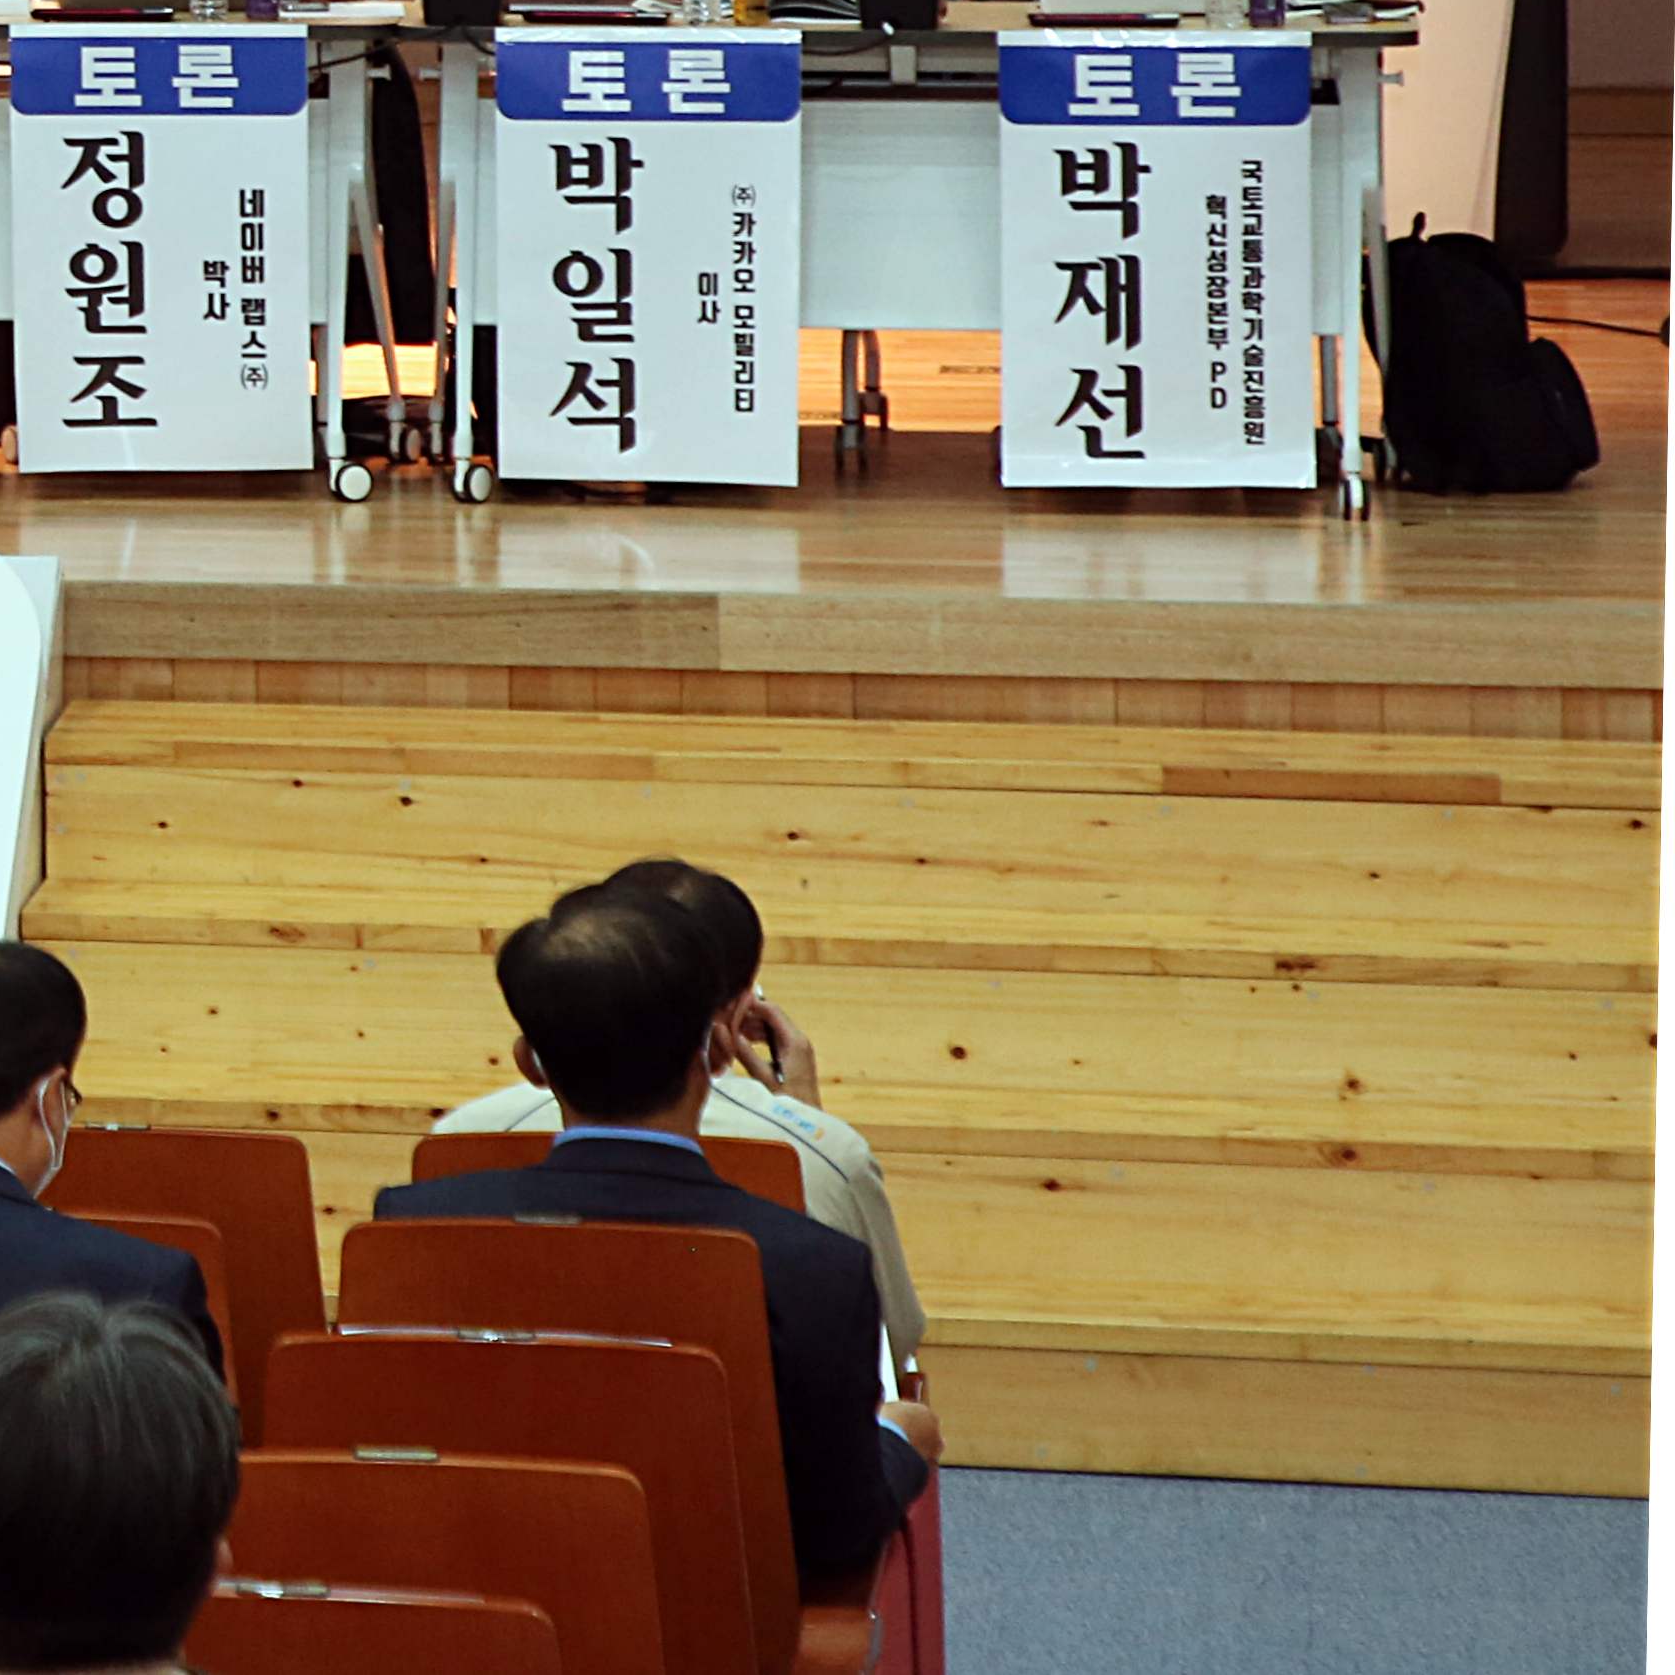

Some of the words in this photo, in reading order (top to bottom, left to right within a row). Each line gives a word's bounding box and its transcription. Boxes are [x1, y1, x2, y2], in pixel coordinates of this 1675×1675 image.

[61, 130, 158, 428] 정원조
[239, 188, 265, 284] 네이버
[202, 260, 231, 321] 박사
[549, 136, 645, 453] 박일석
[697, 272, 721, 324] 이사
[1053, 141, 1152, 459] 박재선
[733, 304, 756, 413] 모빌리티
[1210, 361, 1227, 409] PD
